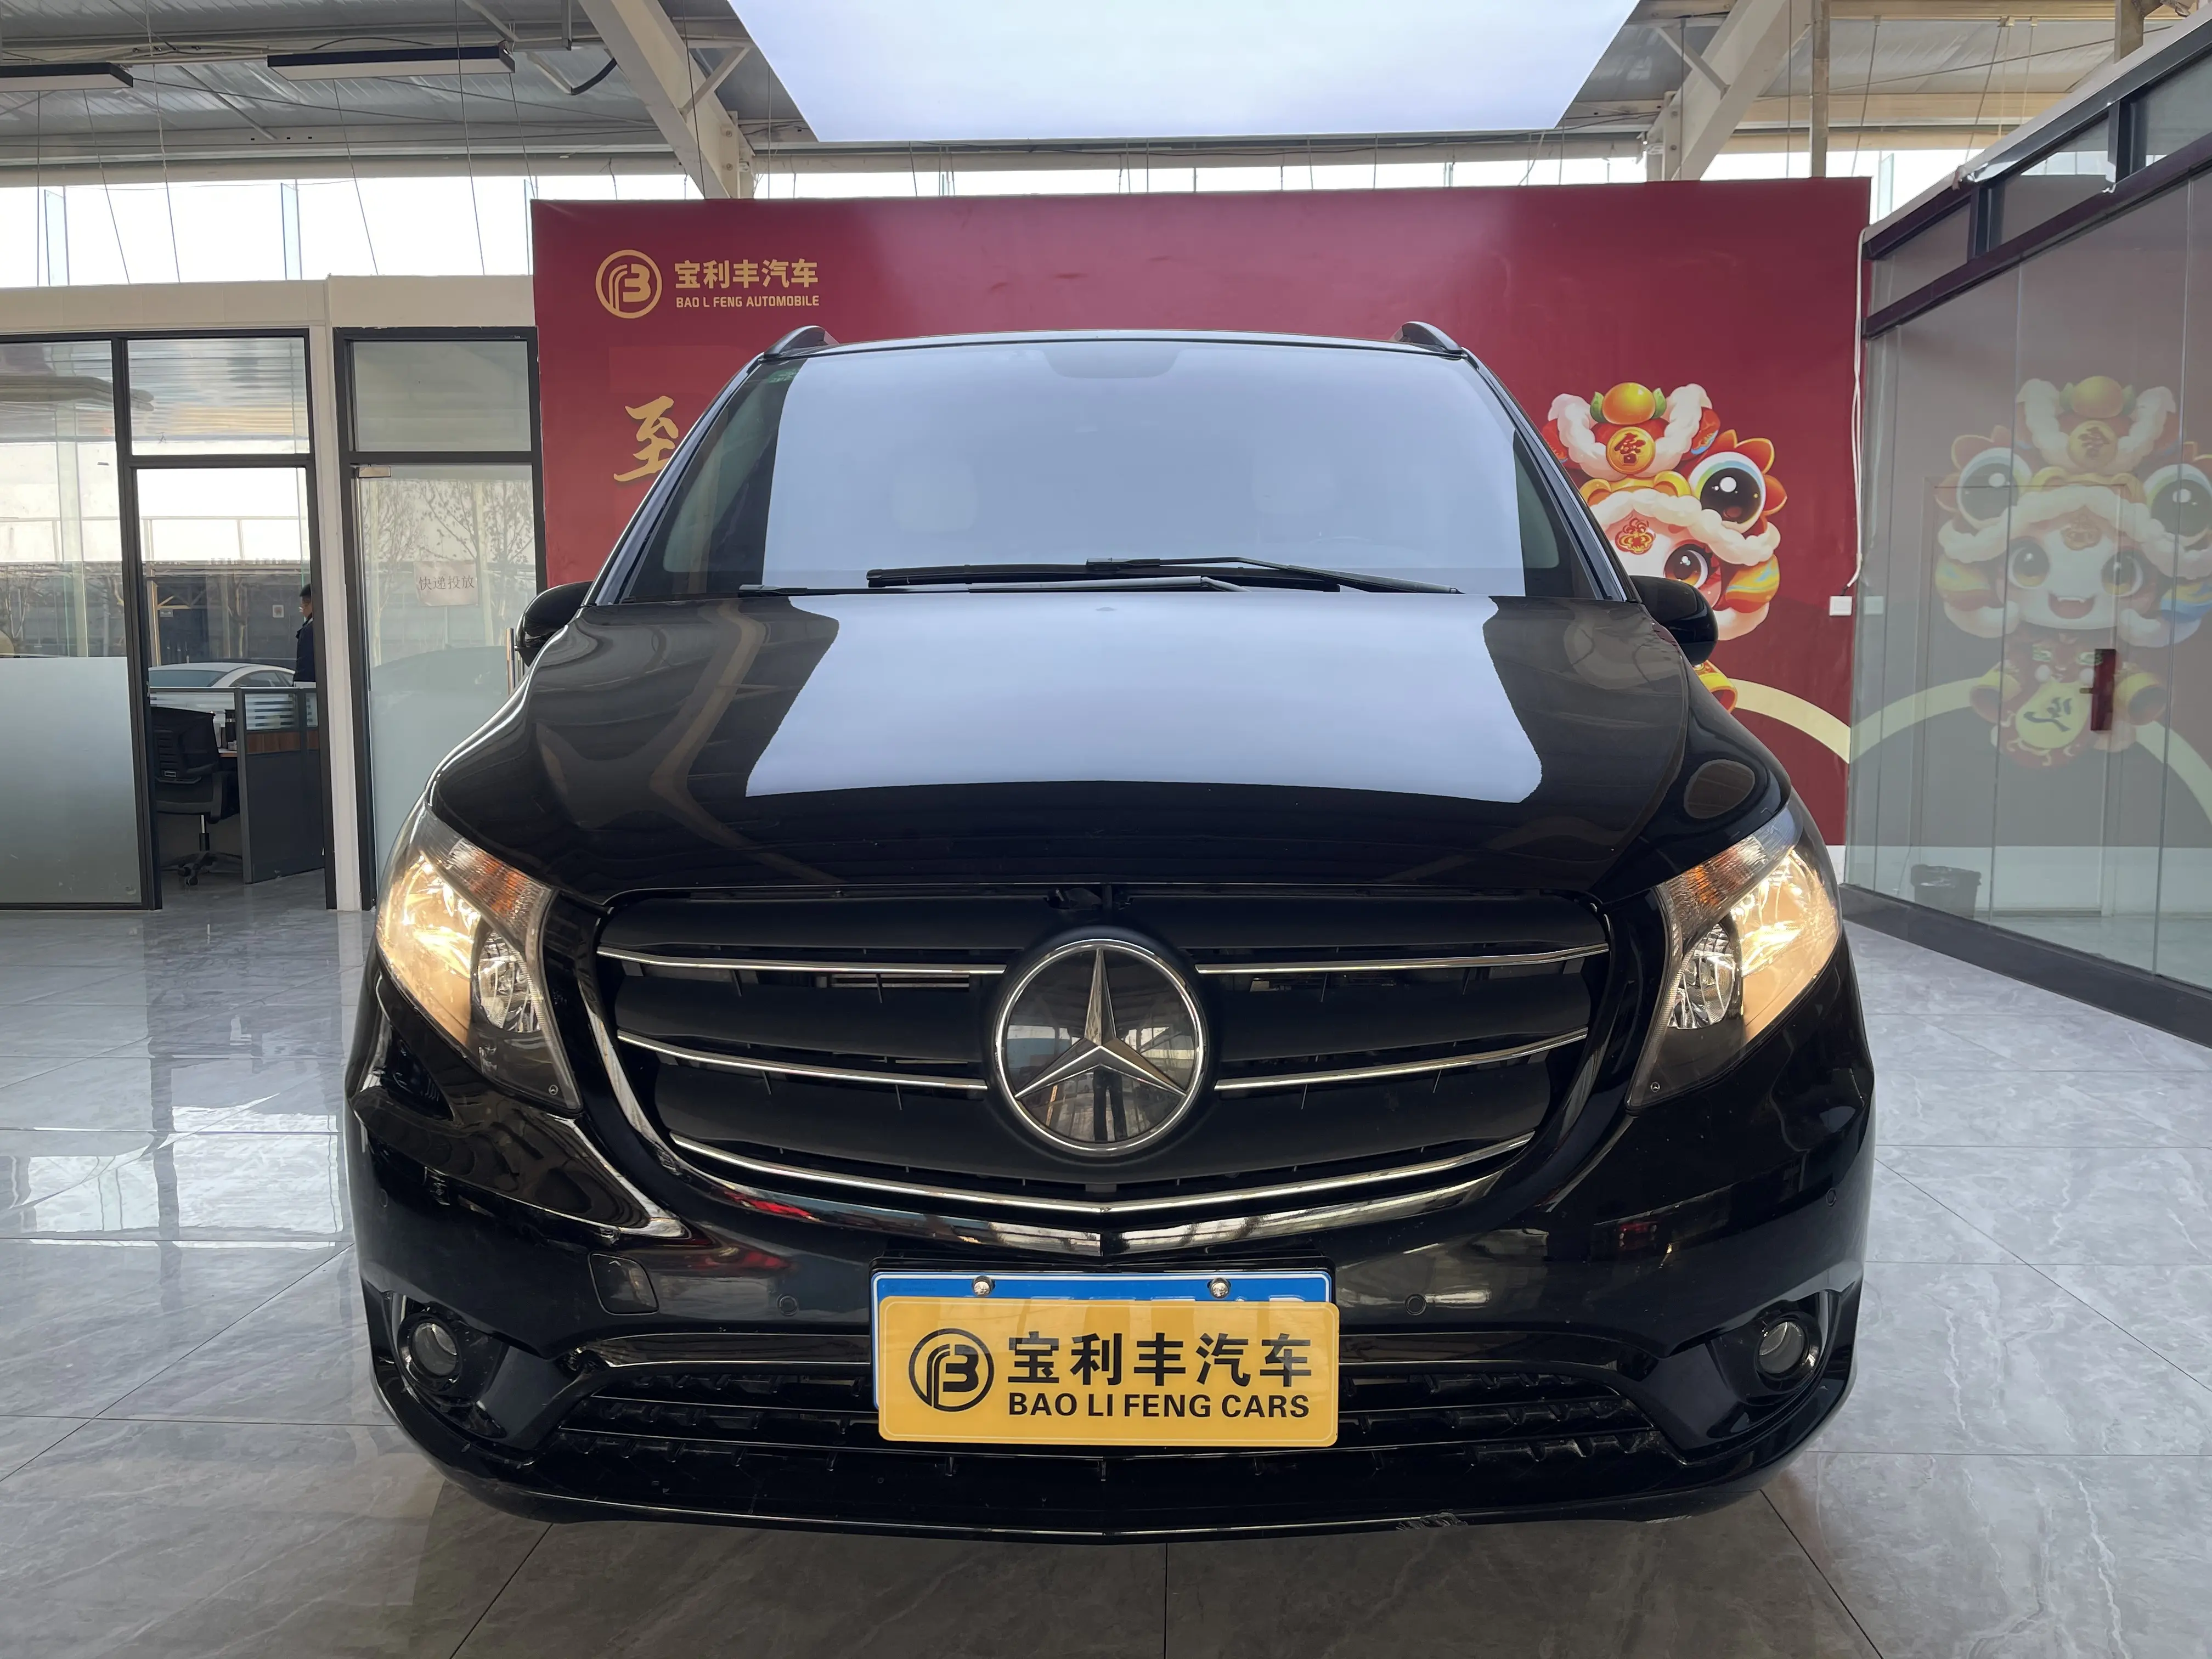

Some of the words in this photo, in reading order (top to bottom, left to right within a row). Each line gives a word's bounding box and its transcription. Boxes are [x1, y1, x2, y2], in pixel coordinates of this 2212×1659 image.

[674, 258, 819, 289] 宝利丰汽车
[676, 297, 699, 308] BAO
[713, 296, 743, 308] FENG
[746, 295, 820, 307] AUTOMOBILE
[418, 574, 475, 590] 快递投放
[1008, 1331, 1312, 1387] 宝利丰汽车
[1009, 1392, 1077, 1417] BAO
[1088, 1393, 1113, 1417] LI
[1124, 1393, 1211, 1418] FENG
[1221, 1394, 1310, 1418] CARS
